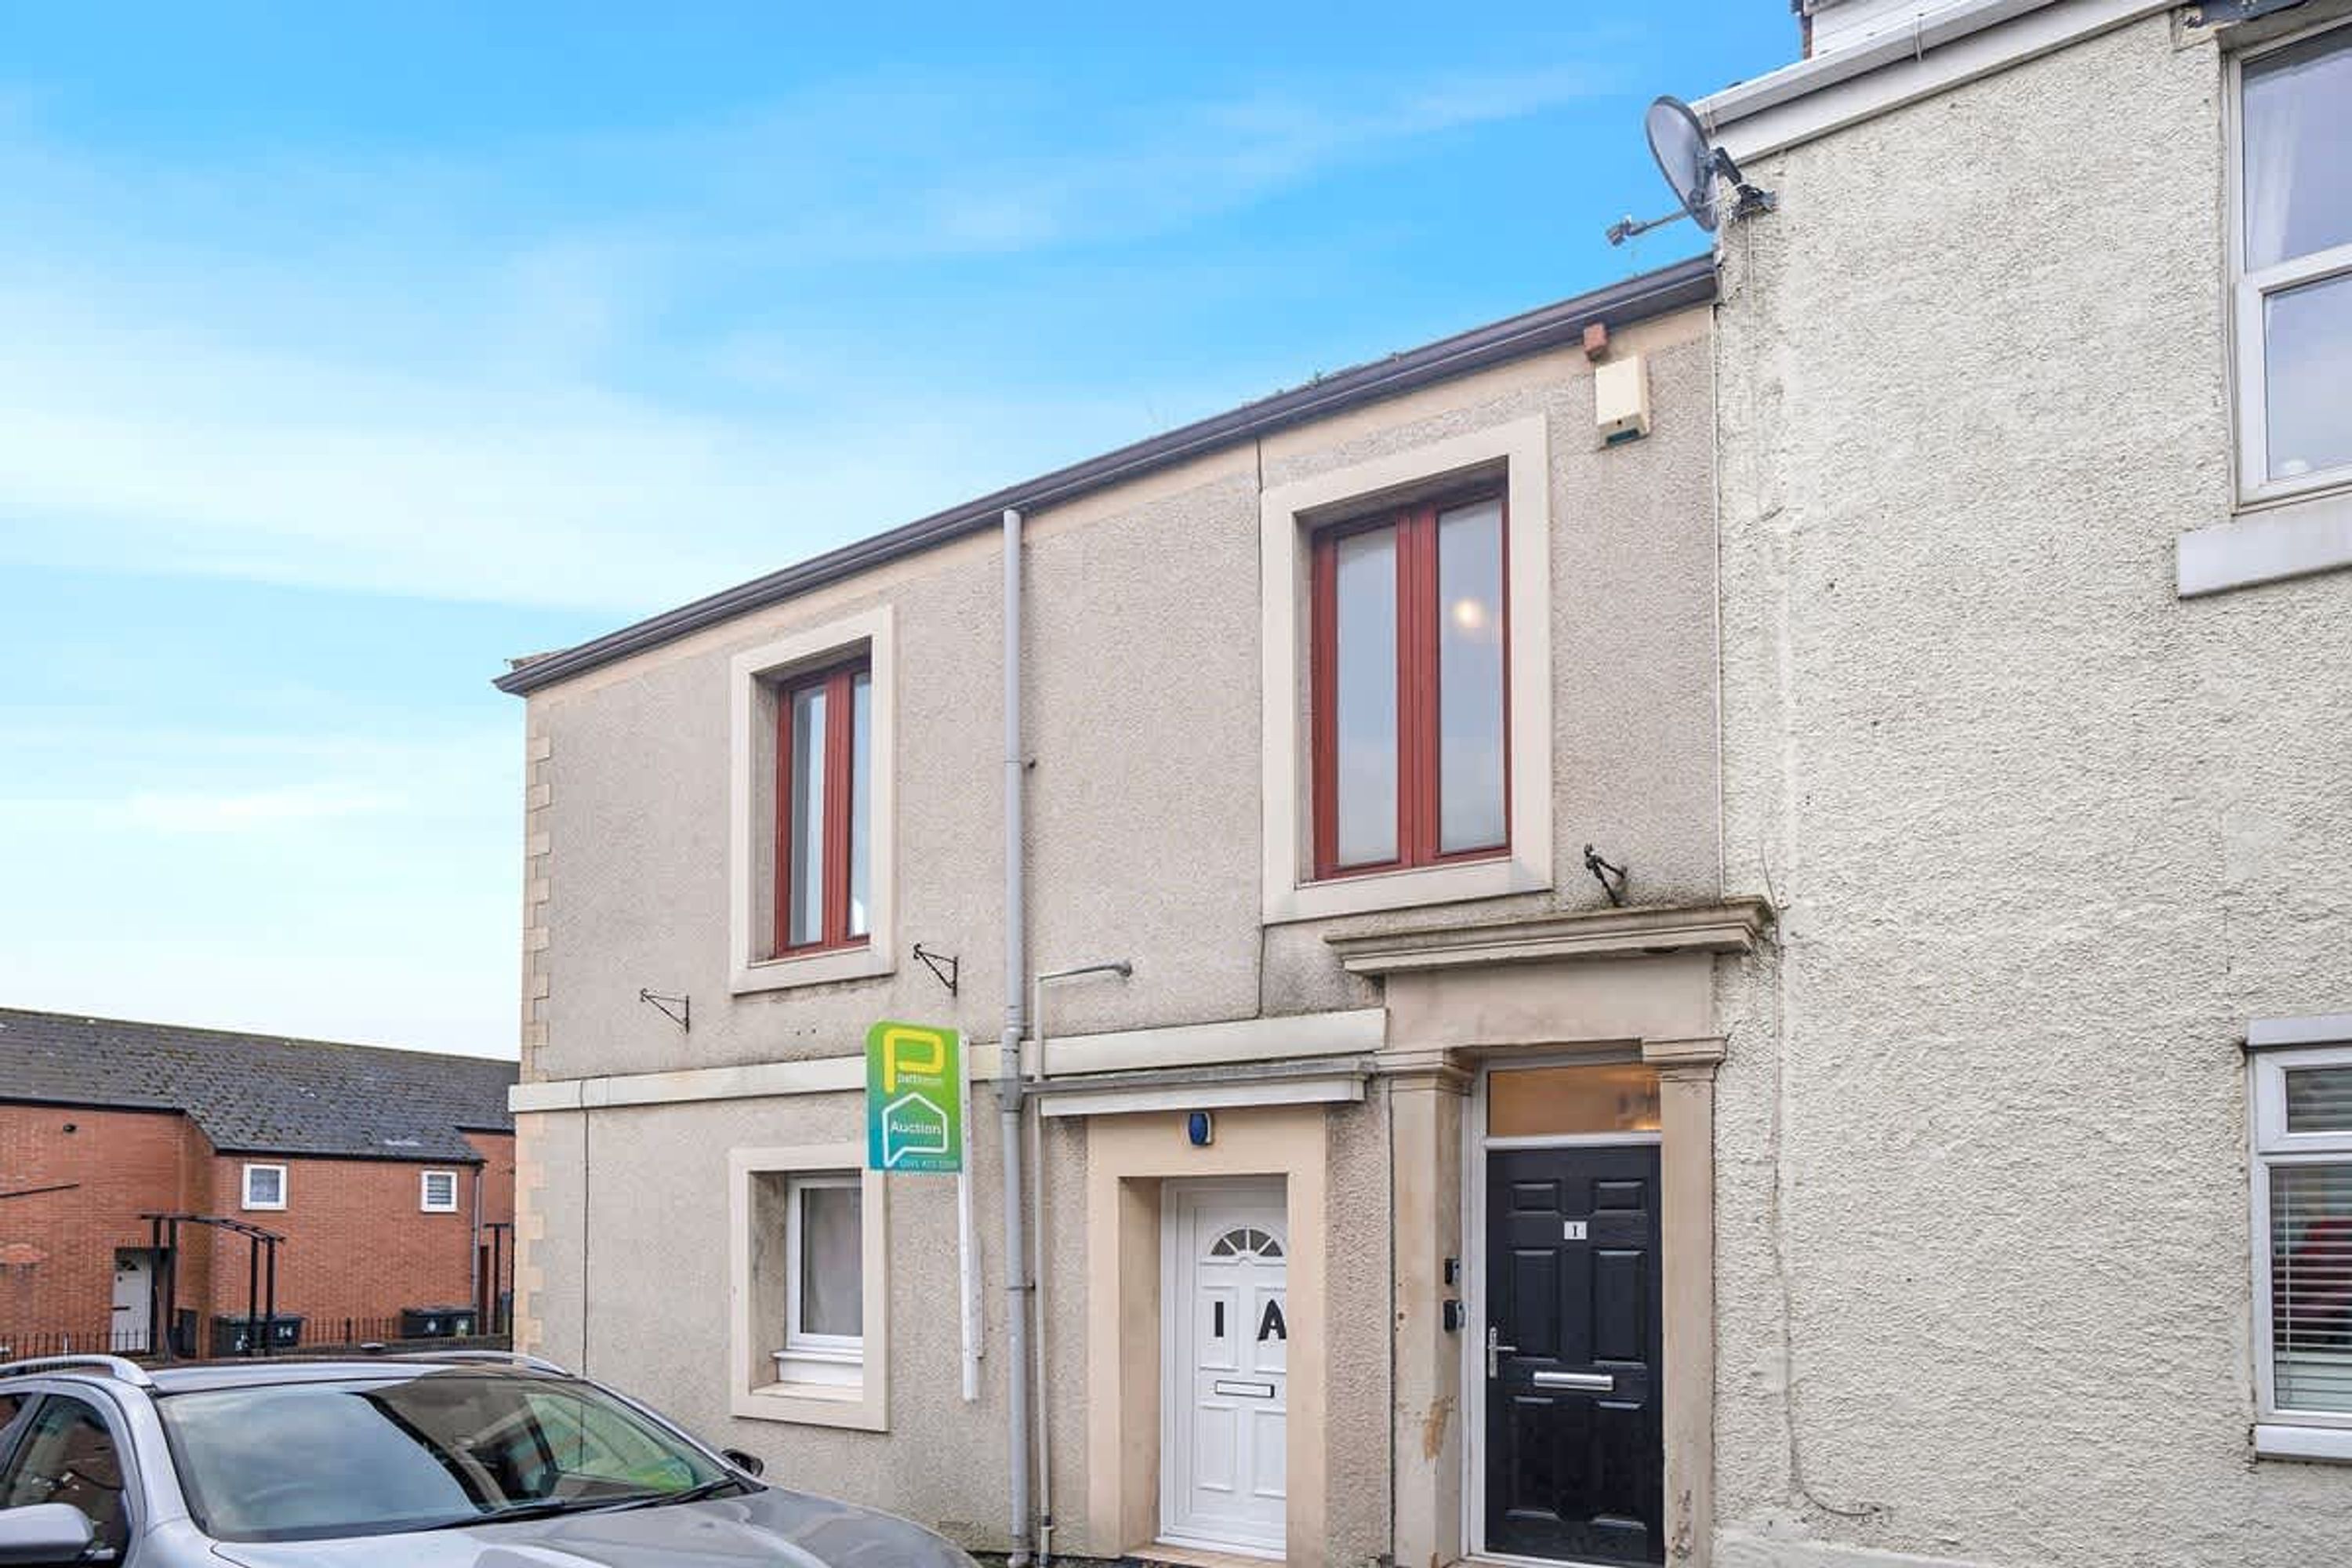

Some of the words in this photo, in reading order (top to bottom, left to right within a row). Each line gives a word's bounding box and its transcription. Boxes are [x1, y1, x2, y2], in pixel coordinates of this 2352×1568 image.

[883, 1028, 945, 1094] P
[891, 1120, 942, 1135] Auction
[1256, 1299, 1287, 1341] A
